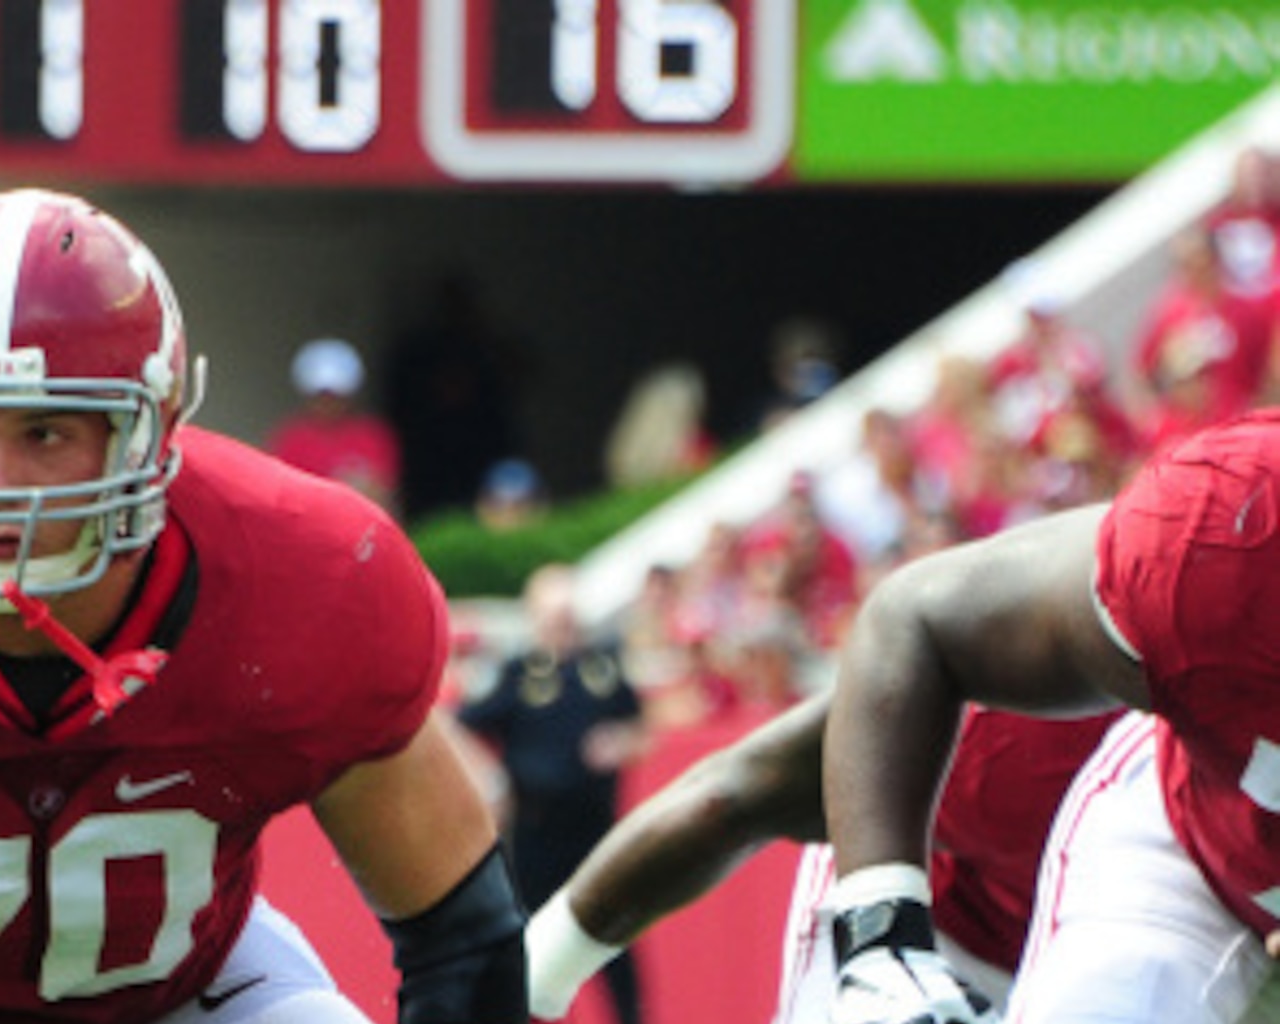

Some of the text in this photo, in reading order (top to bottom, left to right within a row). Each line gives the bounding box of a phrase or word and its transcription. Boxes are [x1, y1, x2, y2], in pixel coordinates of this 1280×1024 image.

[222, 0, 382, 152] 10
[550, 0, 738, 122] 16
[955, 0, 1280, 84] REGION
